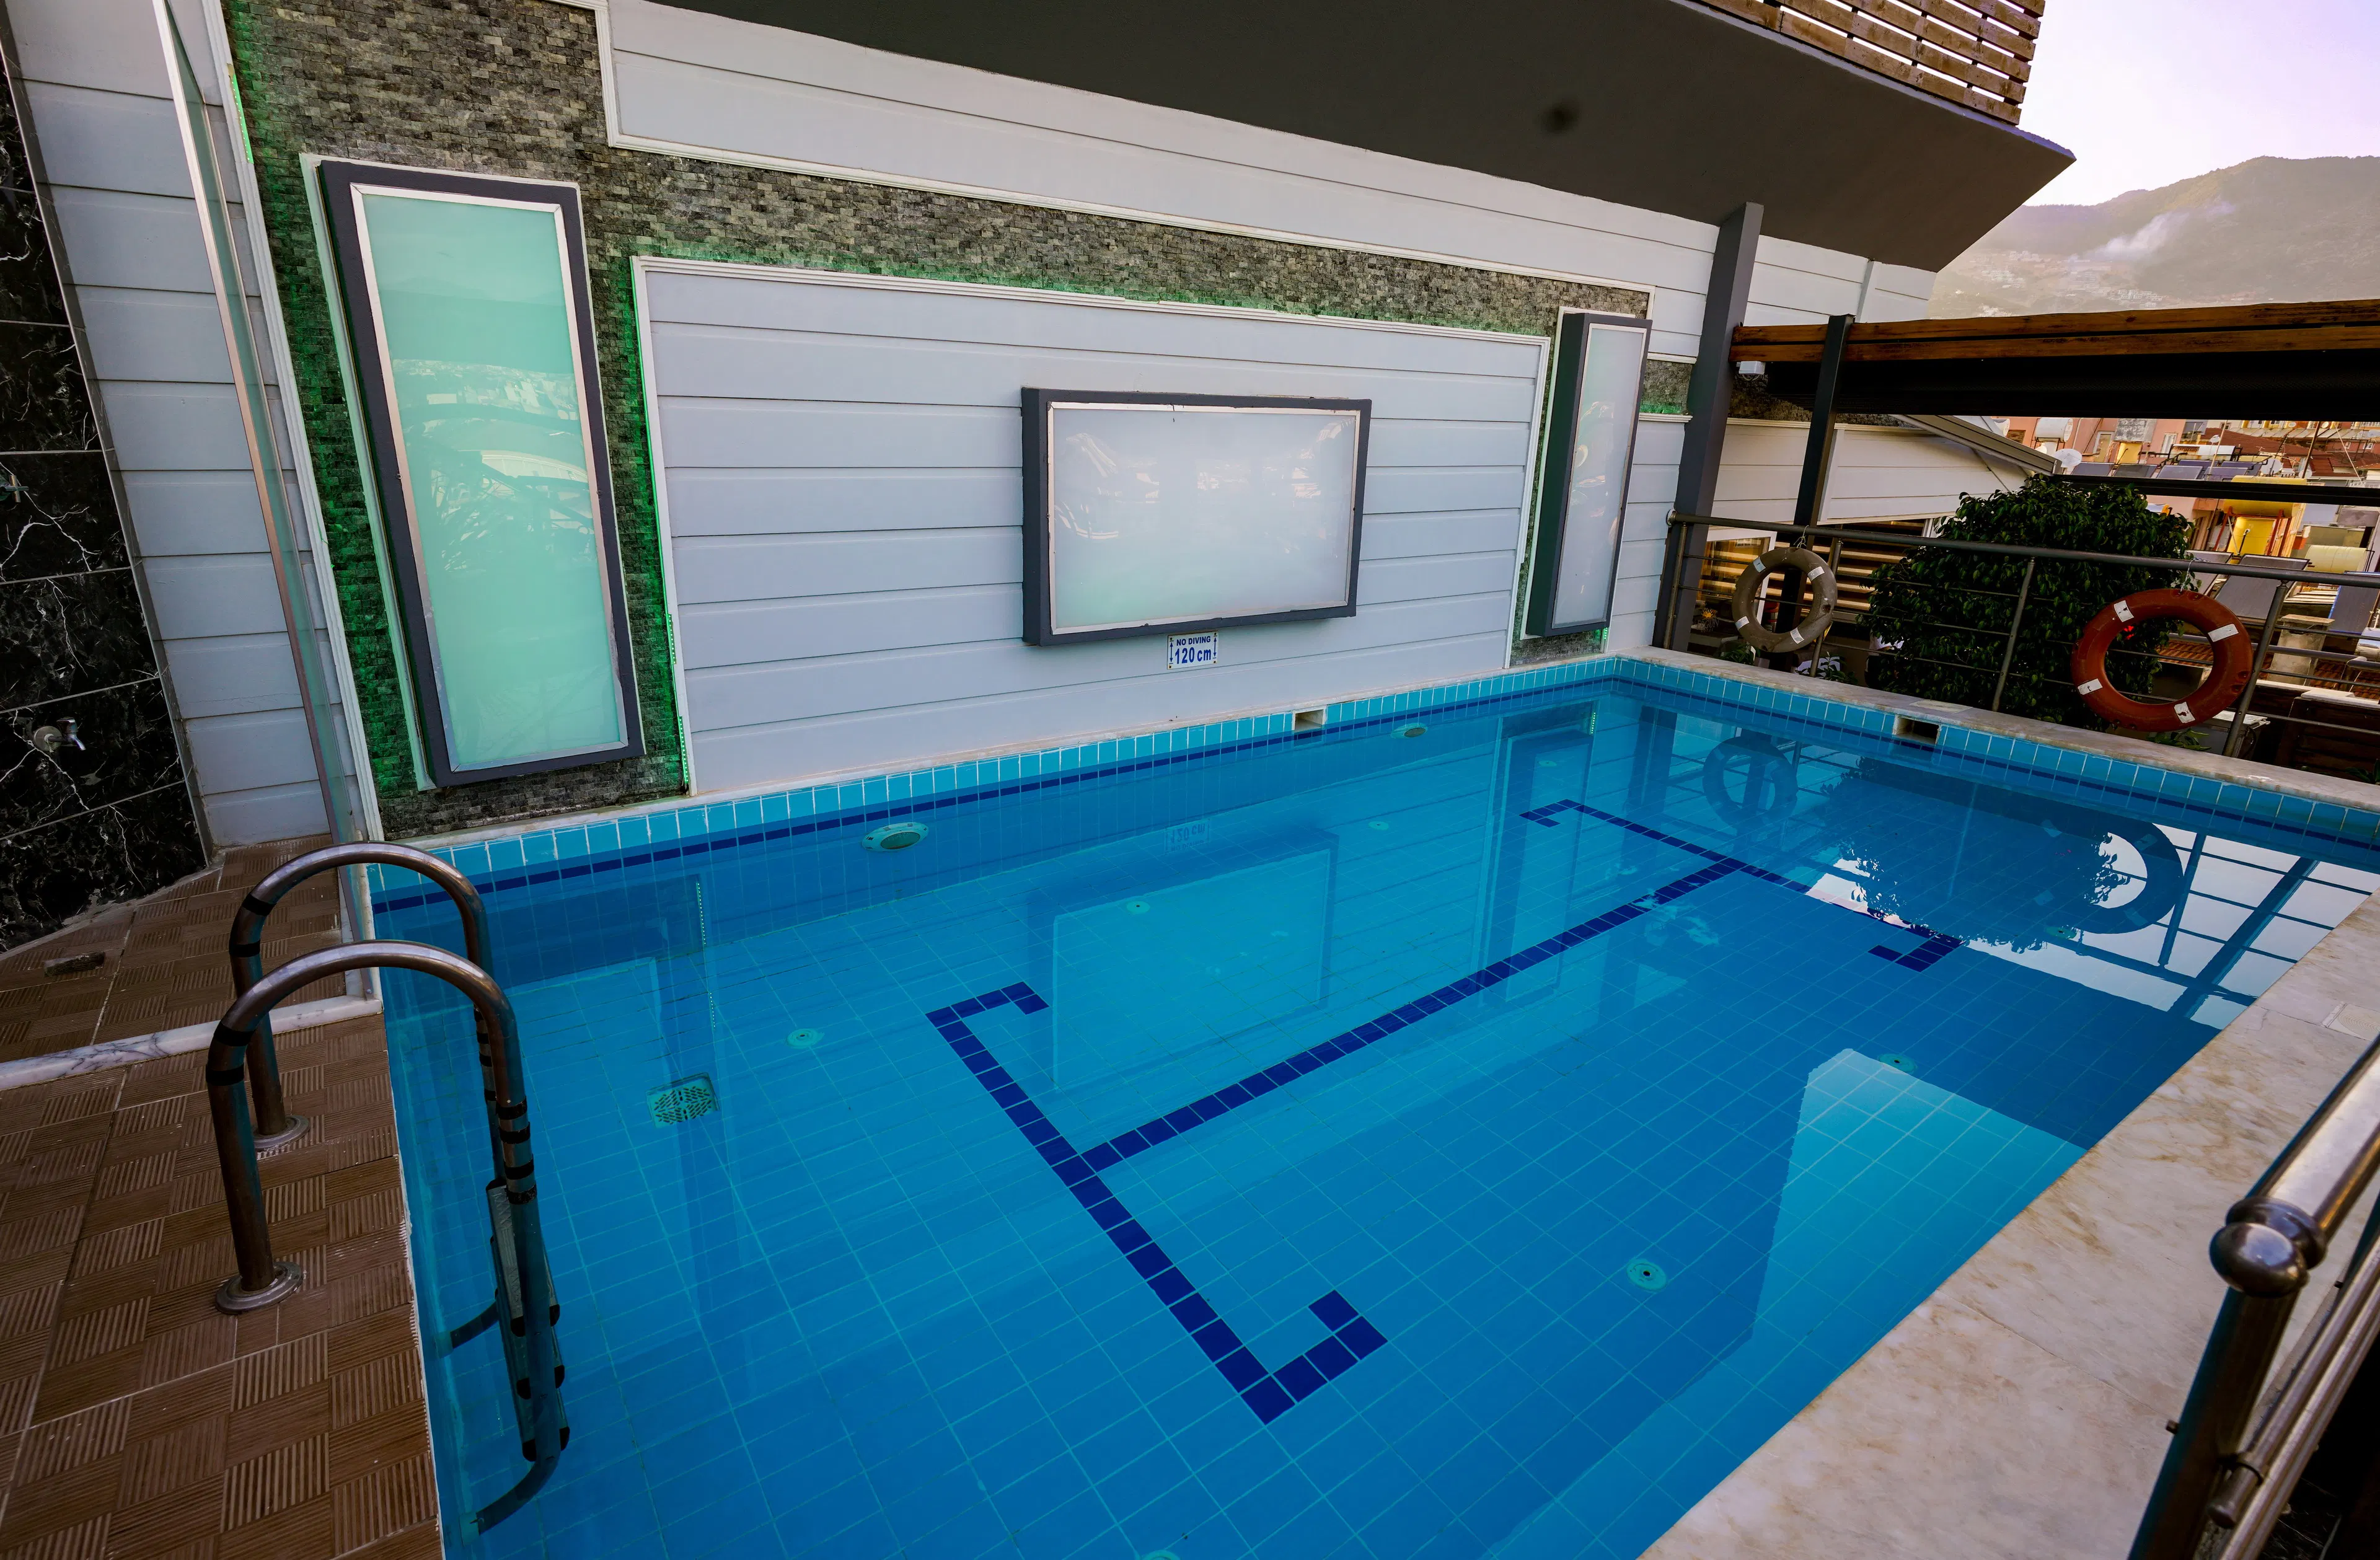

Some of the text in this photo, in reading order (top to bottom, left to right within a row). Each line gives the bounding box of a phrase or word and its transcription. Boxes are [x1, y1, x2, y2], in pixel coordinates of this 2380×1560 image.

[1188, 636, 1211, 645] DIVING
[1175, 647, 1211, 664] 120 cm
